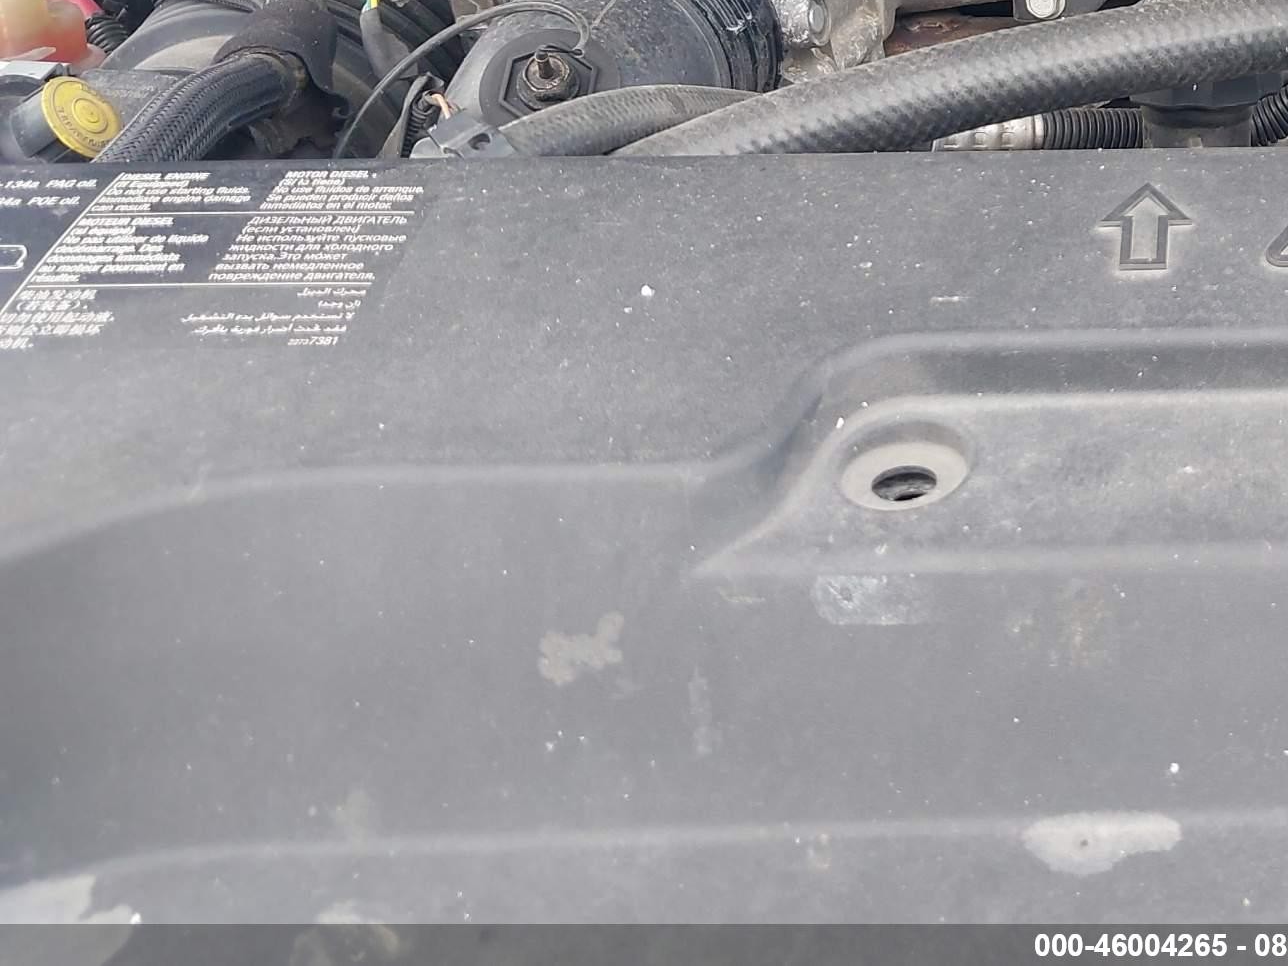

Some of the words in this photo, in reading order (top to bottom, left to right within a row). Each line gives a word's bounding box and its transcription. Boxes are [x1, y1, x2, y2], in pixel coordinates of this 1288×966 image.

[164, 172, 211, 180] ENGINE
[286, 171, 330, 179] MOTOR
[46, 180, 76, 188] PAG
[107, 188, 127, 196] Do
[129, 188, 144, 196] not
[145, 188, 169, 196] use
[169, 187, 214, 196] starting
[272, 186, 289, 194] No
[314, 186, 354, 194] fluidos
[356, 186, 370, 194] de
[27, 196, 60, 206] POE
[99, 195, 160, 203] Immediate
[162, 195, 202, 204] engine
[203, 195, 251, 204] damage
[266, 194, 283, 202] Se
[284, 194, 329, 202] pueden
[329, 194, 377, 202] producir
[378, 194, 414, 202] daños
[343, 202, 357, 210] el
[78, 217, 132, 226] MOTEUR
[132, 217, 174, 226] DIESEL
[248, 216, 333, 225] ДИЗЕЛЬНЫЙ
[333, 215, 408, 225] ДВИГАТЕЛЬ
[242, 225, 278, 234] (если
[280, 225, 361, 234] установлен)
[63, 236, 82, 244] Ne
[82, 236, 105, 244] pas
[106, 235, 147, 244] utiliser
[149, 235, 168, 243] de
[168, 234, 209, 244] liquide
[235, 234, 255, 242] Не
[257, 234, 341, 244] используйте
[343, 234, 407, 244] пусковые
[138, 244, 164, 252] Des
[228, 244, 294, 252] жидкости
[295, 244, 320, 252] для
[322, 244, 394, 252] холодного
[46, 254, 114, 264] dommages
[115, 253, 180, 262] immédiats
[38, 264, 56, 272] au
[57, 264, 101, 272] moteur
[101, 263, 166, 274] pourraient
[167, 263, 185, 272] en
[215, 262, 270, 271] вызвать
[272, 262, 365, 271] немедленное
[208, 272, 302, 281] повреждение
[303, 271, 376, 281] двигателя.
